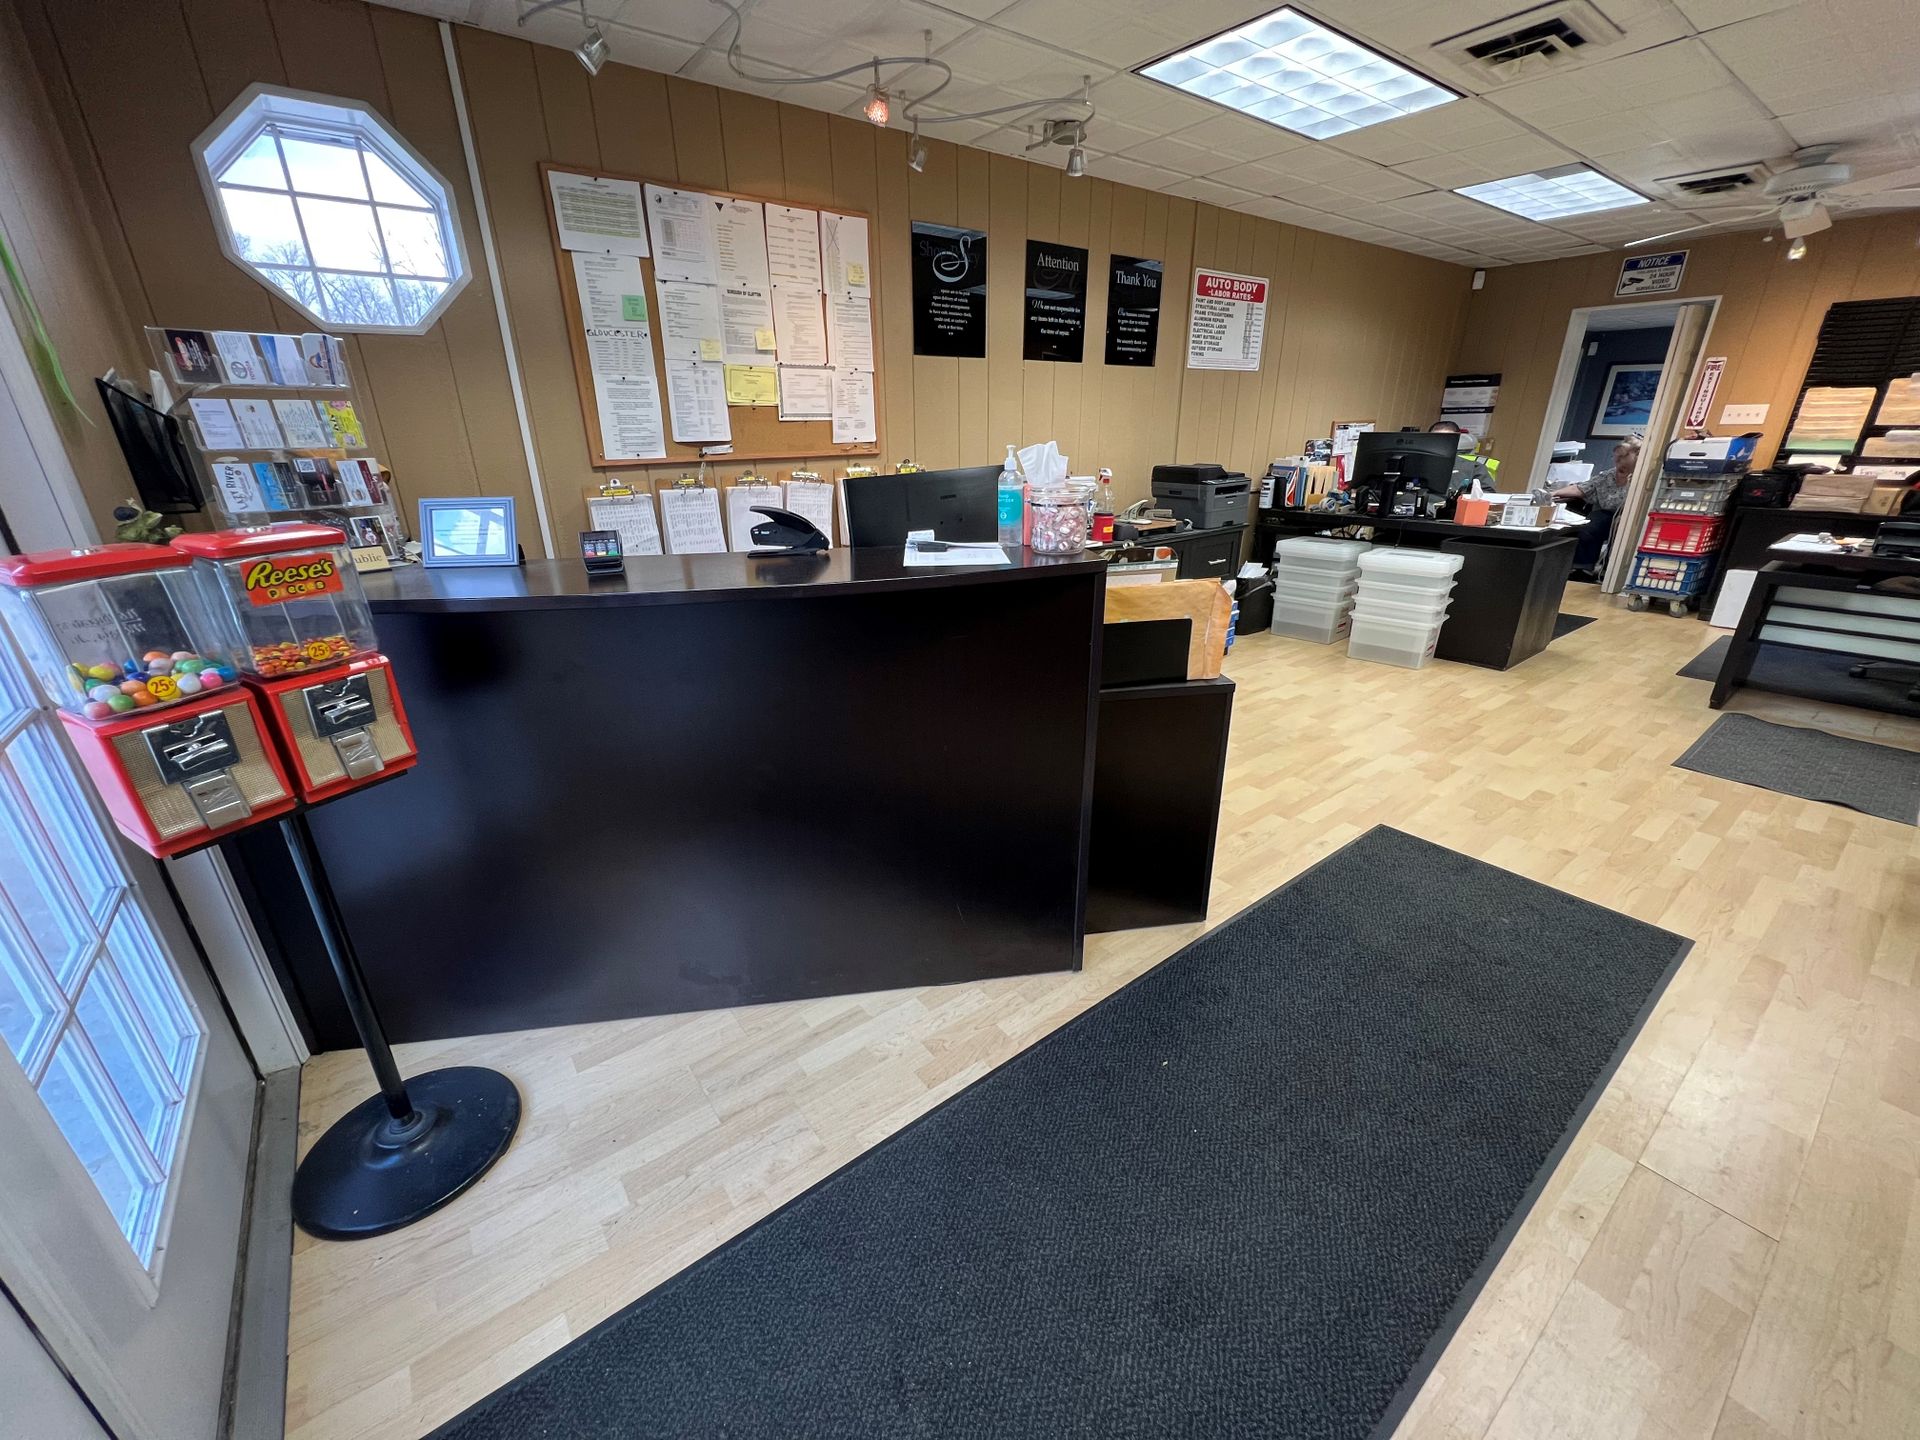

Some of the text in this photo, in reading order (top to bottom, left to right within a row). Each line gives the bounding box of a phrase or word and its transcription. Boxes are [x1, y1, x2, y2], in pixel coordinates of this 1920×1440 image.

[1037, 252, 1079, 271] Attention
[1637, 256, 1671, 268] NOTICE
[1116, 270, 1157, 288] Thank You
[1205, 277, 1258, 293] AUTO BODY
[587, 329, 644, 339] GLOUCESTER
[245, 361, 256, 380] TOYOTA
[1694, 372, 1714, 423] EXTINGUISHER
[225, 465, 236, 488] RIVER
[230, 490, 248, 510] LAZY
[246, 558, 334, 591] Reese's
[268, 581, 325, 599] PECS
[151, 679, 175, 694] 25¢
